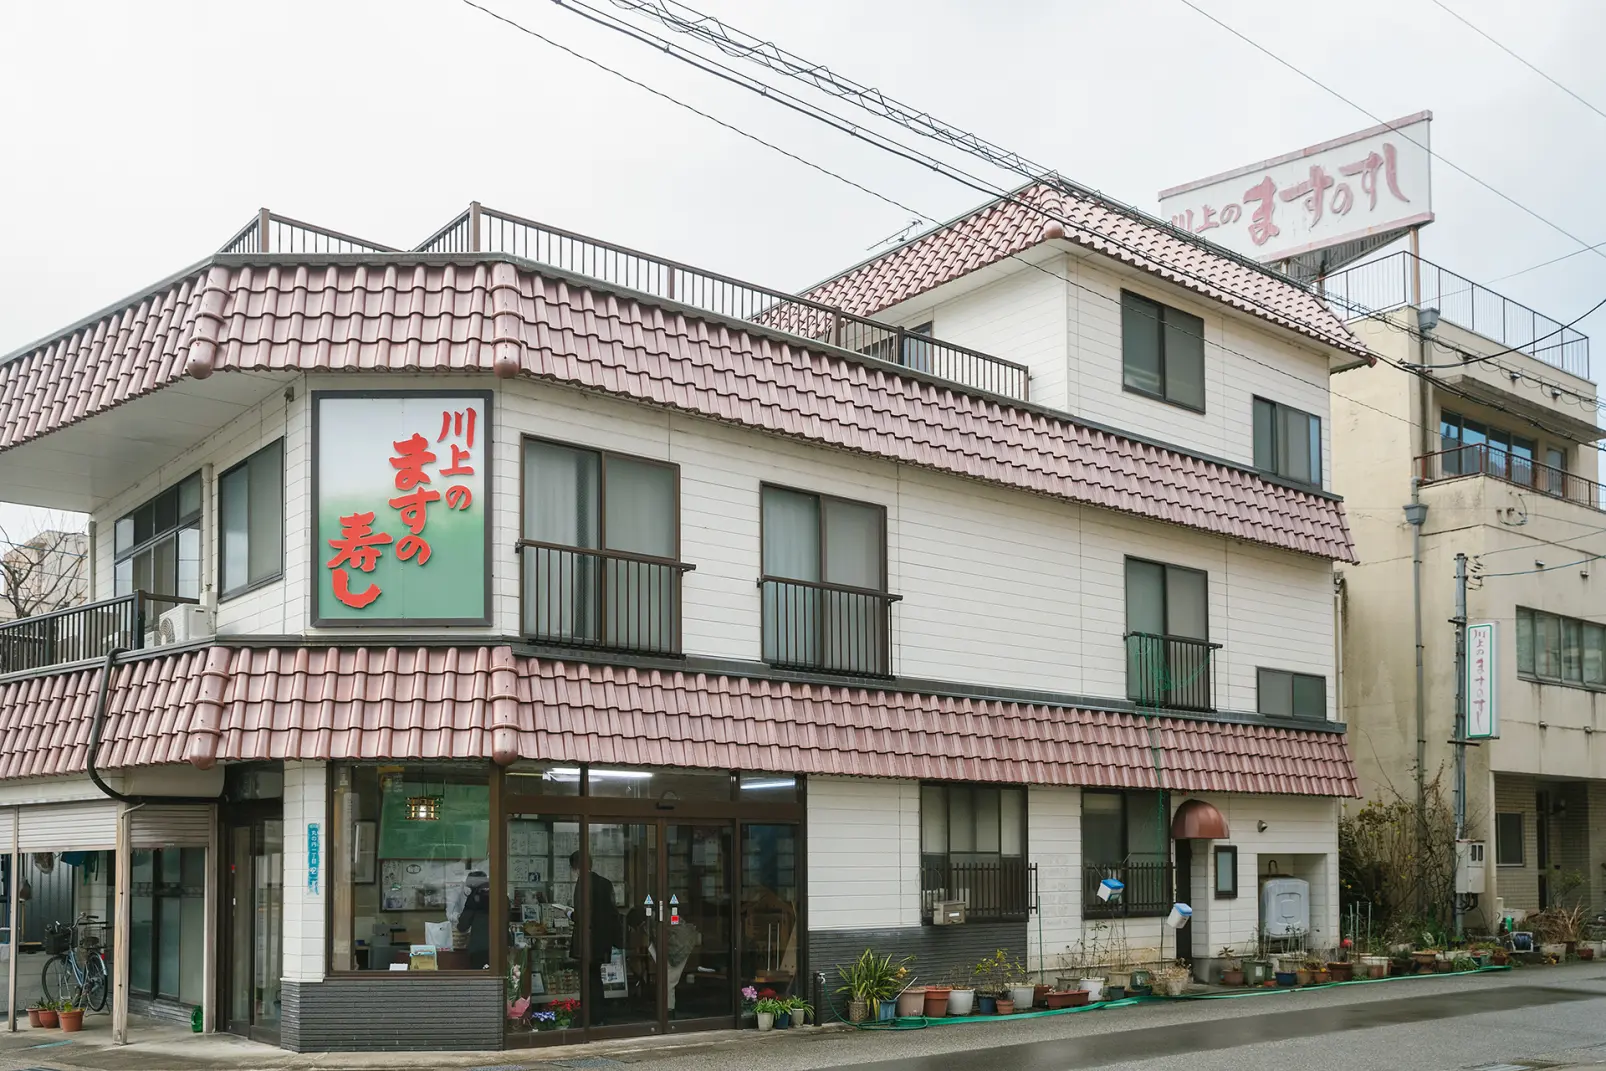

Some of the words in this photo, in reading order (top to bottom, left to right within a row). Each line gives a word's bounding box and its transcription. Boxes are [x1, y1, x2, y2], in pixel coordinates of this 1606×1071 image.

[388, 432, 441, 566] ますの
[437, 407, 477, 511] 川上の
[327, 511, 393, 609] 寿し
